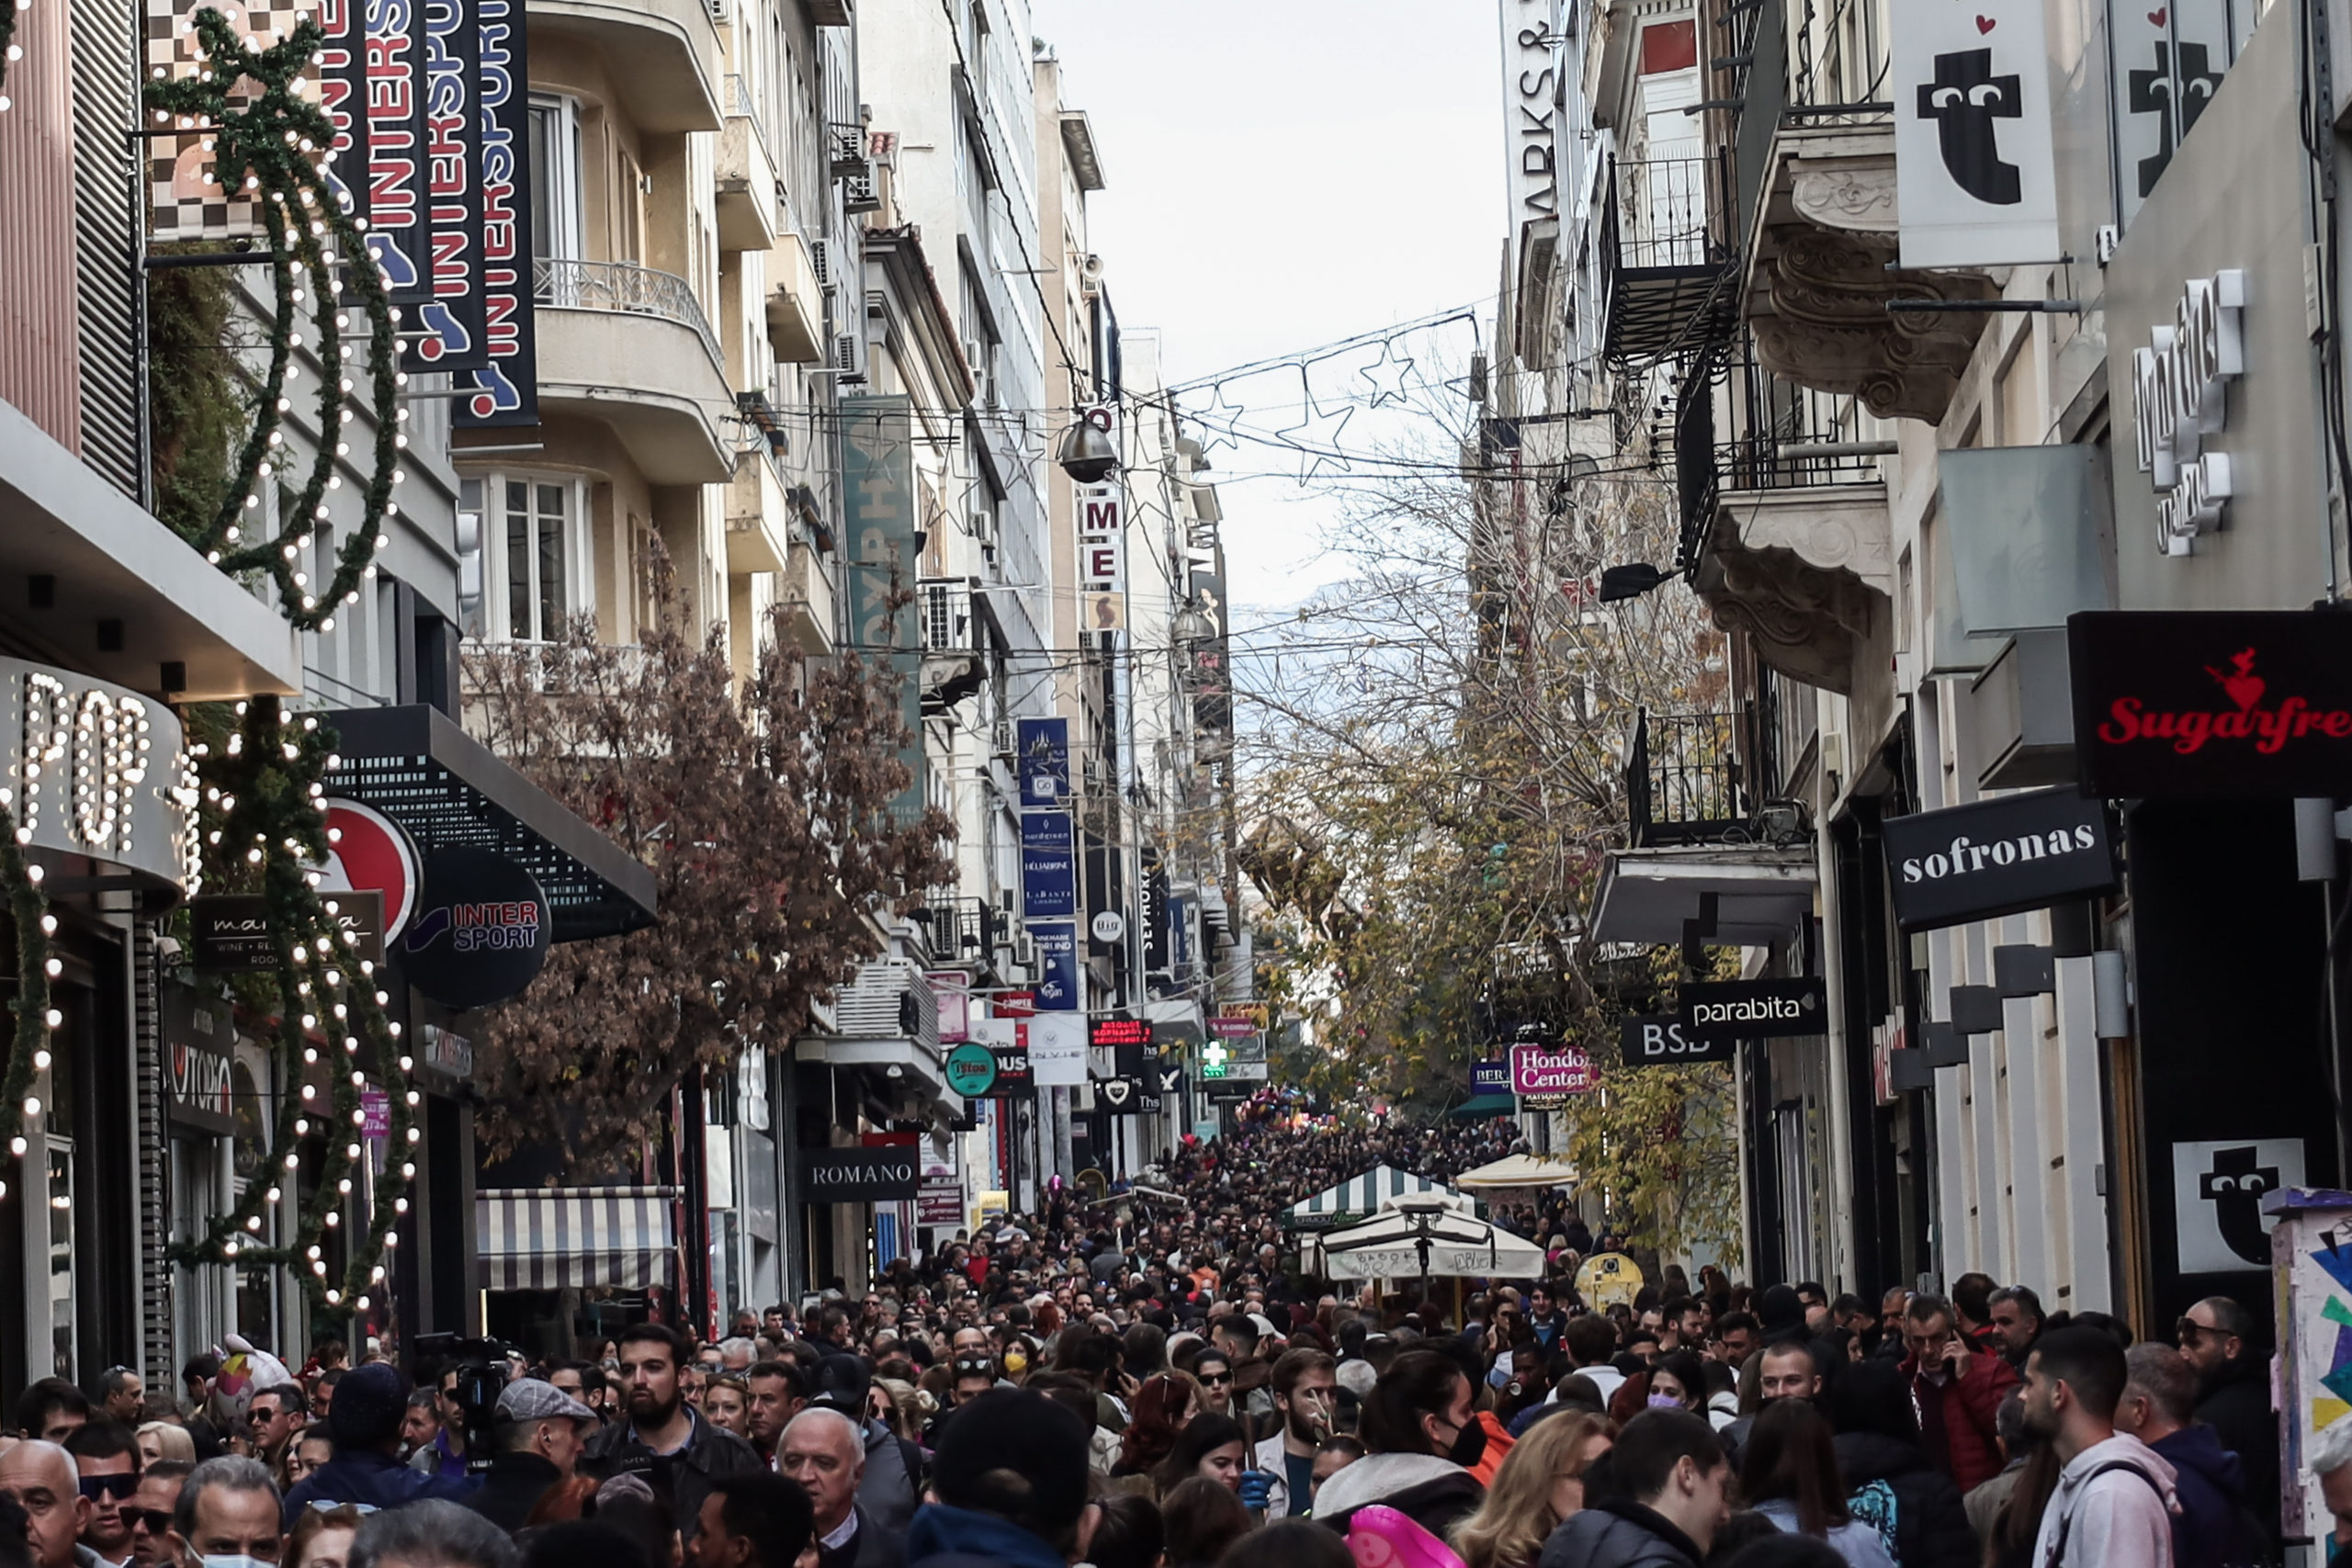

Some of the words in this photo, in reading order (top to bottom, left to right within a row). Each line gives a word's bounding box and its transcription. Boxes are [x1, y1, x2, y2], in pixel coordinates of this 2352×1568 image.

[1903, 822, 2096, 884] sofronas
[454, 900, 538, 927] INTER
[454, 924, 539, 952] SPORT
[251, 955, 277, 964] ROO
[1693, 996, 1800, 1027] parabita
[1521, 1069, 1587, 1088] Center
[812, 1164, 911, 1184] ROMANO
